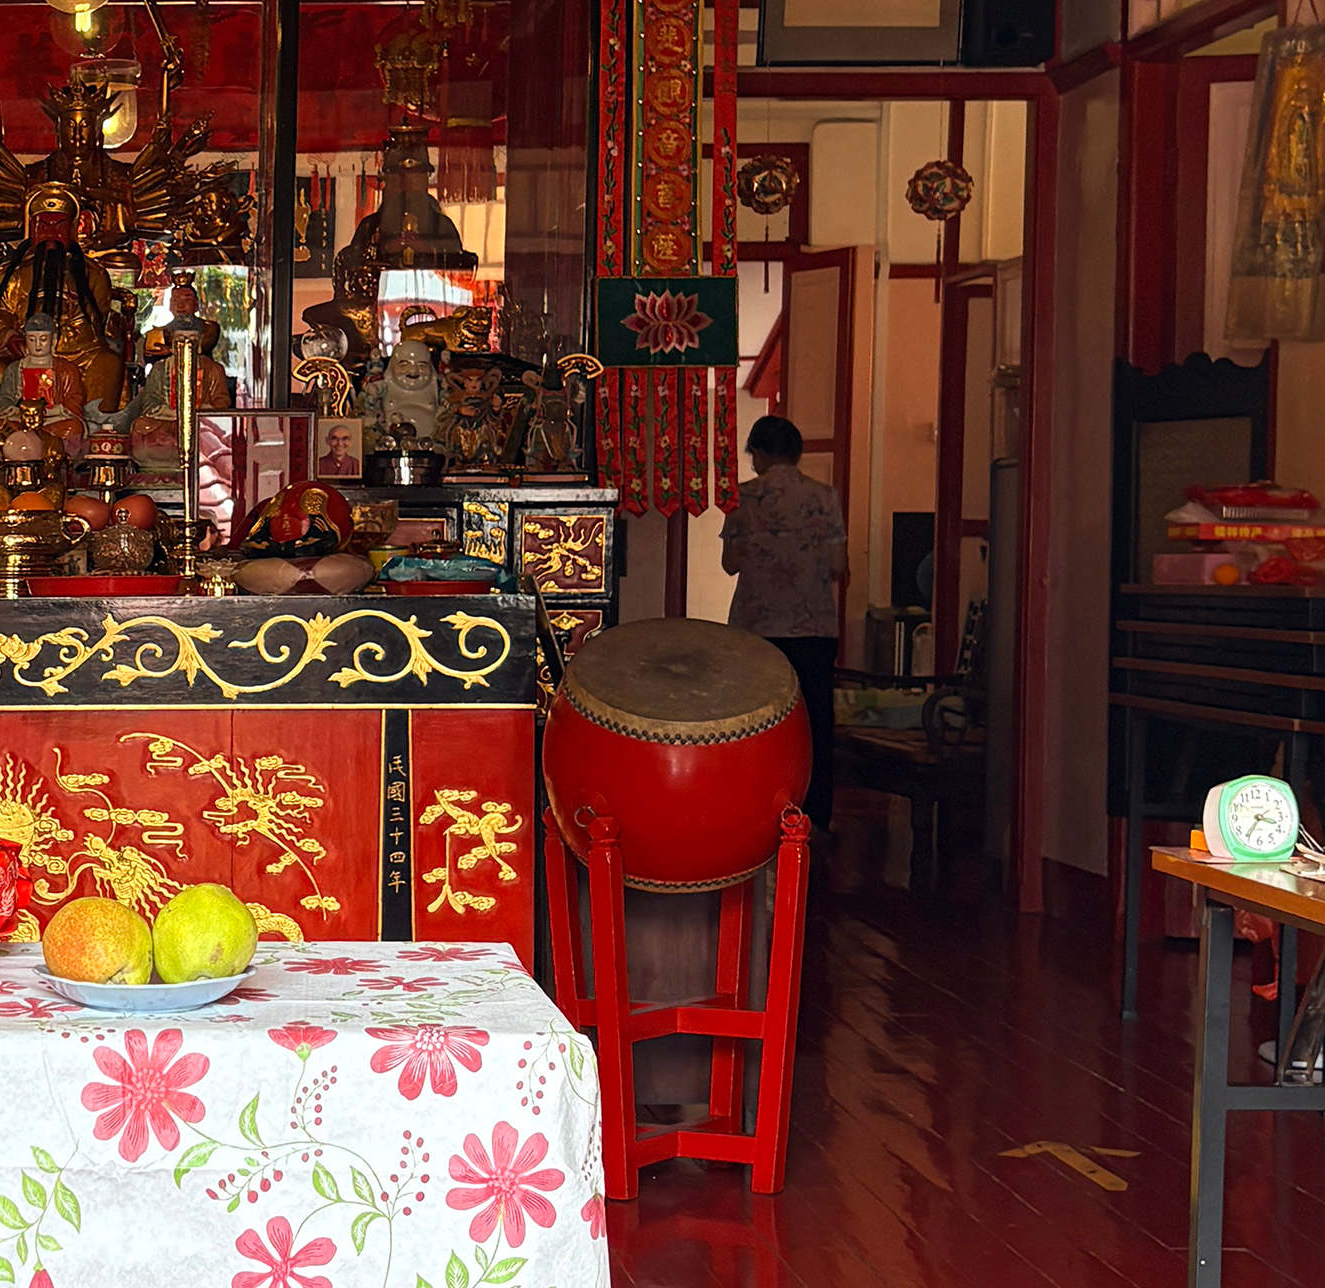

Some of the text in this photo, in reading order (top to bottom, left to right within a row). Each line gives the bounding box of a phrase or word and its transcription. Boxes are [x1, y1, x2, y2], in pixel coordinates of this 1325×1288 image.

[386, 754, 407, 894] 民國三十四年
